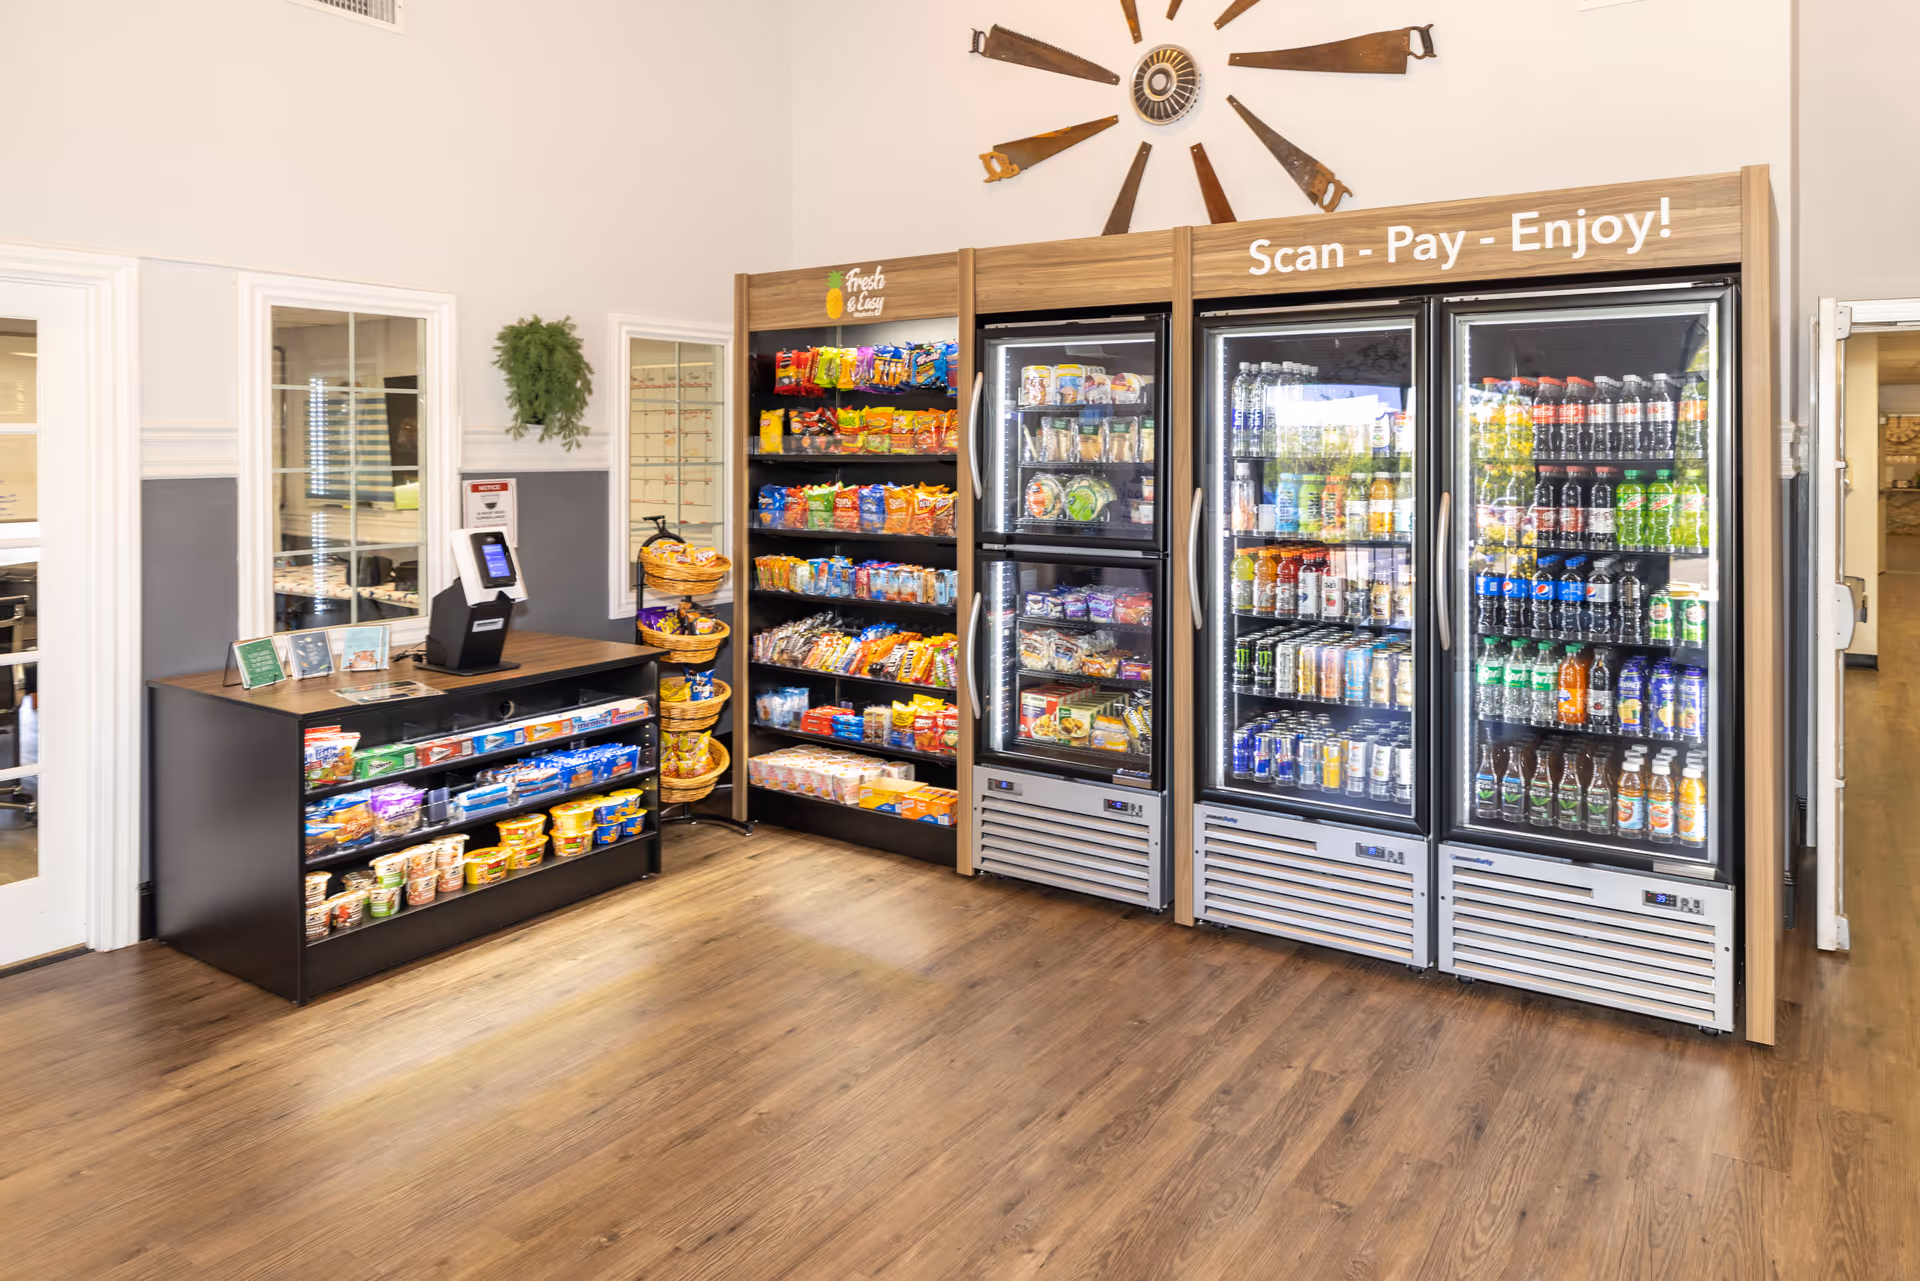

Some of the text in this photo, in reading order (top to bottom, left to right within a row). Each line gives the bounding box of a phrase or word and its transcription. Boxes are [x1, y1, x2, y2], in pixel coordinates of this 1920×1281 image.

[1248, 196, 1672, 276] Scan - Pay - Enjoy!
[845, 265, 886, 293] Fresh
[846, 290, 885, 316] & Easy
[577, 718, 609, 730] mentos
[615, 710, 645, 721] mentos
[368, 760, 393, 771] Trident
